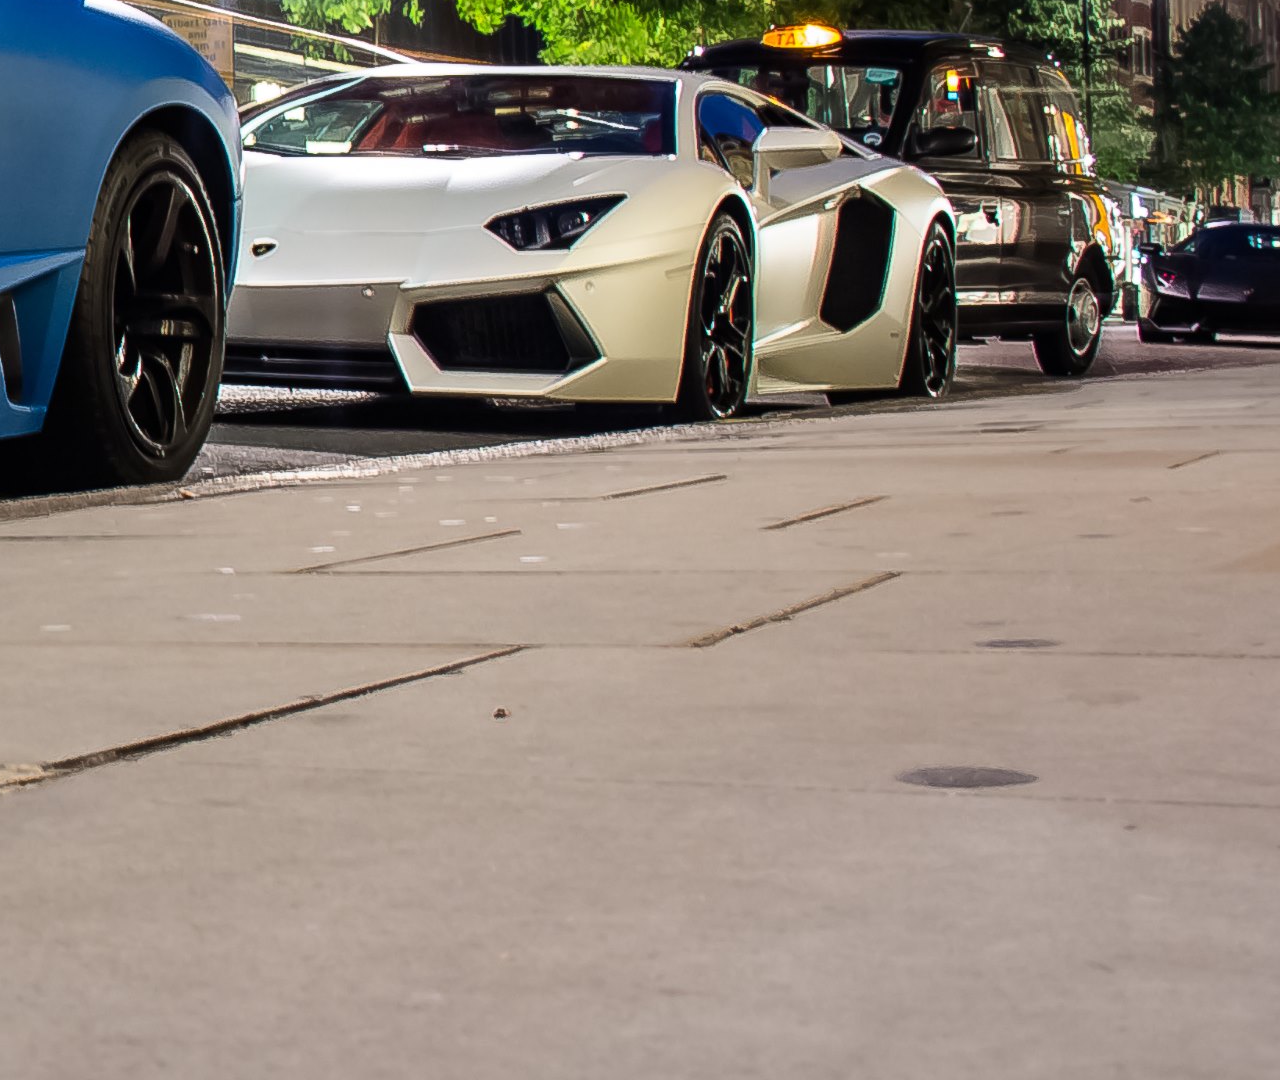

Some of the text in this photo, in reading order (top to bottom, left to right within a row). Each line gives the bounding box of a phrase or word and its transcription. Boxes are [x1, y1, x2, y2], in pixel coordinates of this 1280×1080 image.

[166, 18, 199, 28] Albert
[188, 29, 207, 39] and
[777, 33, 819, 46] TAX
